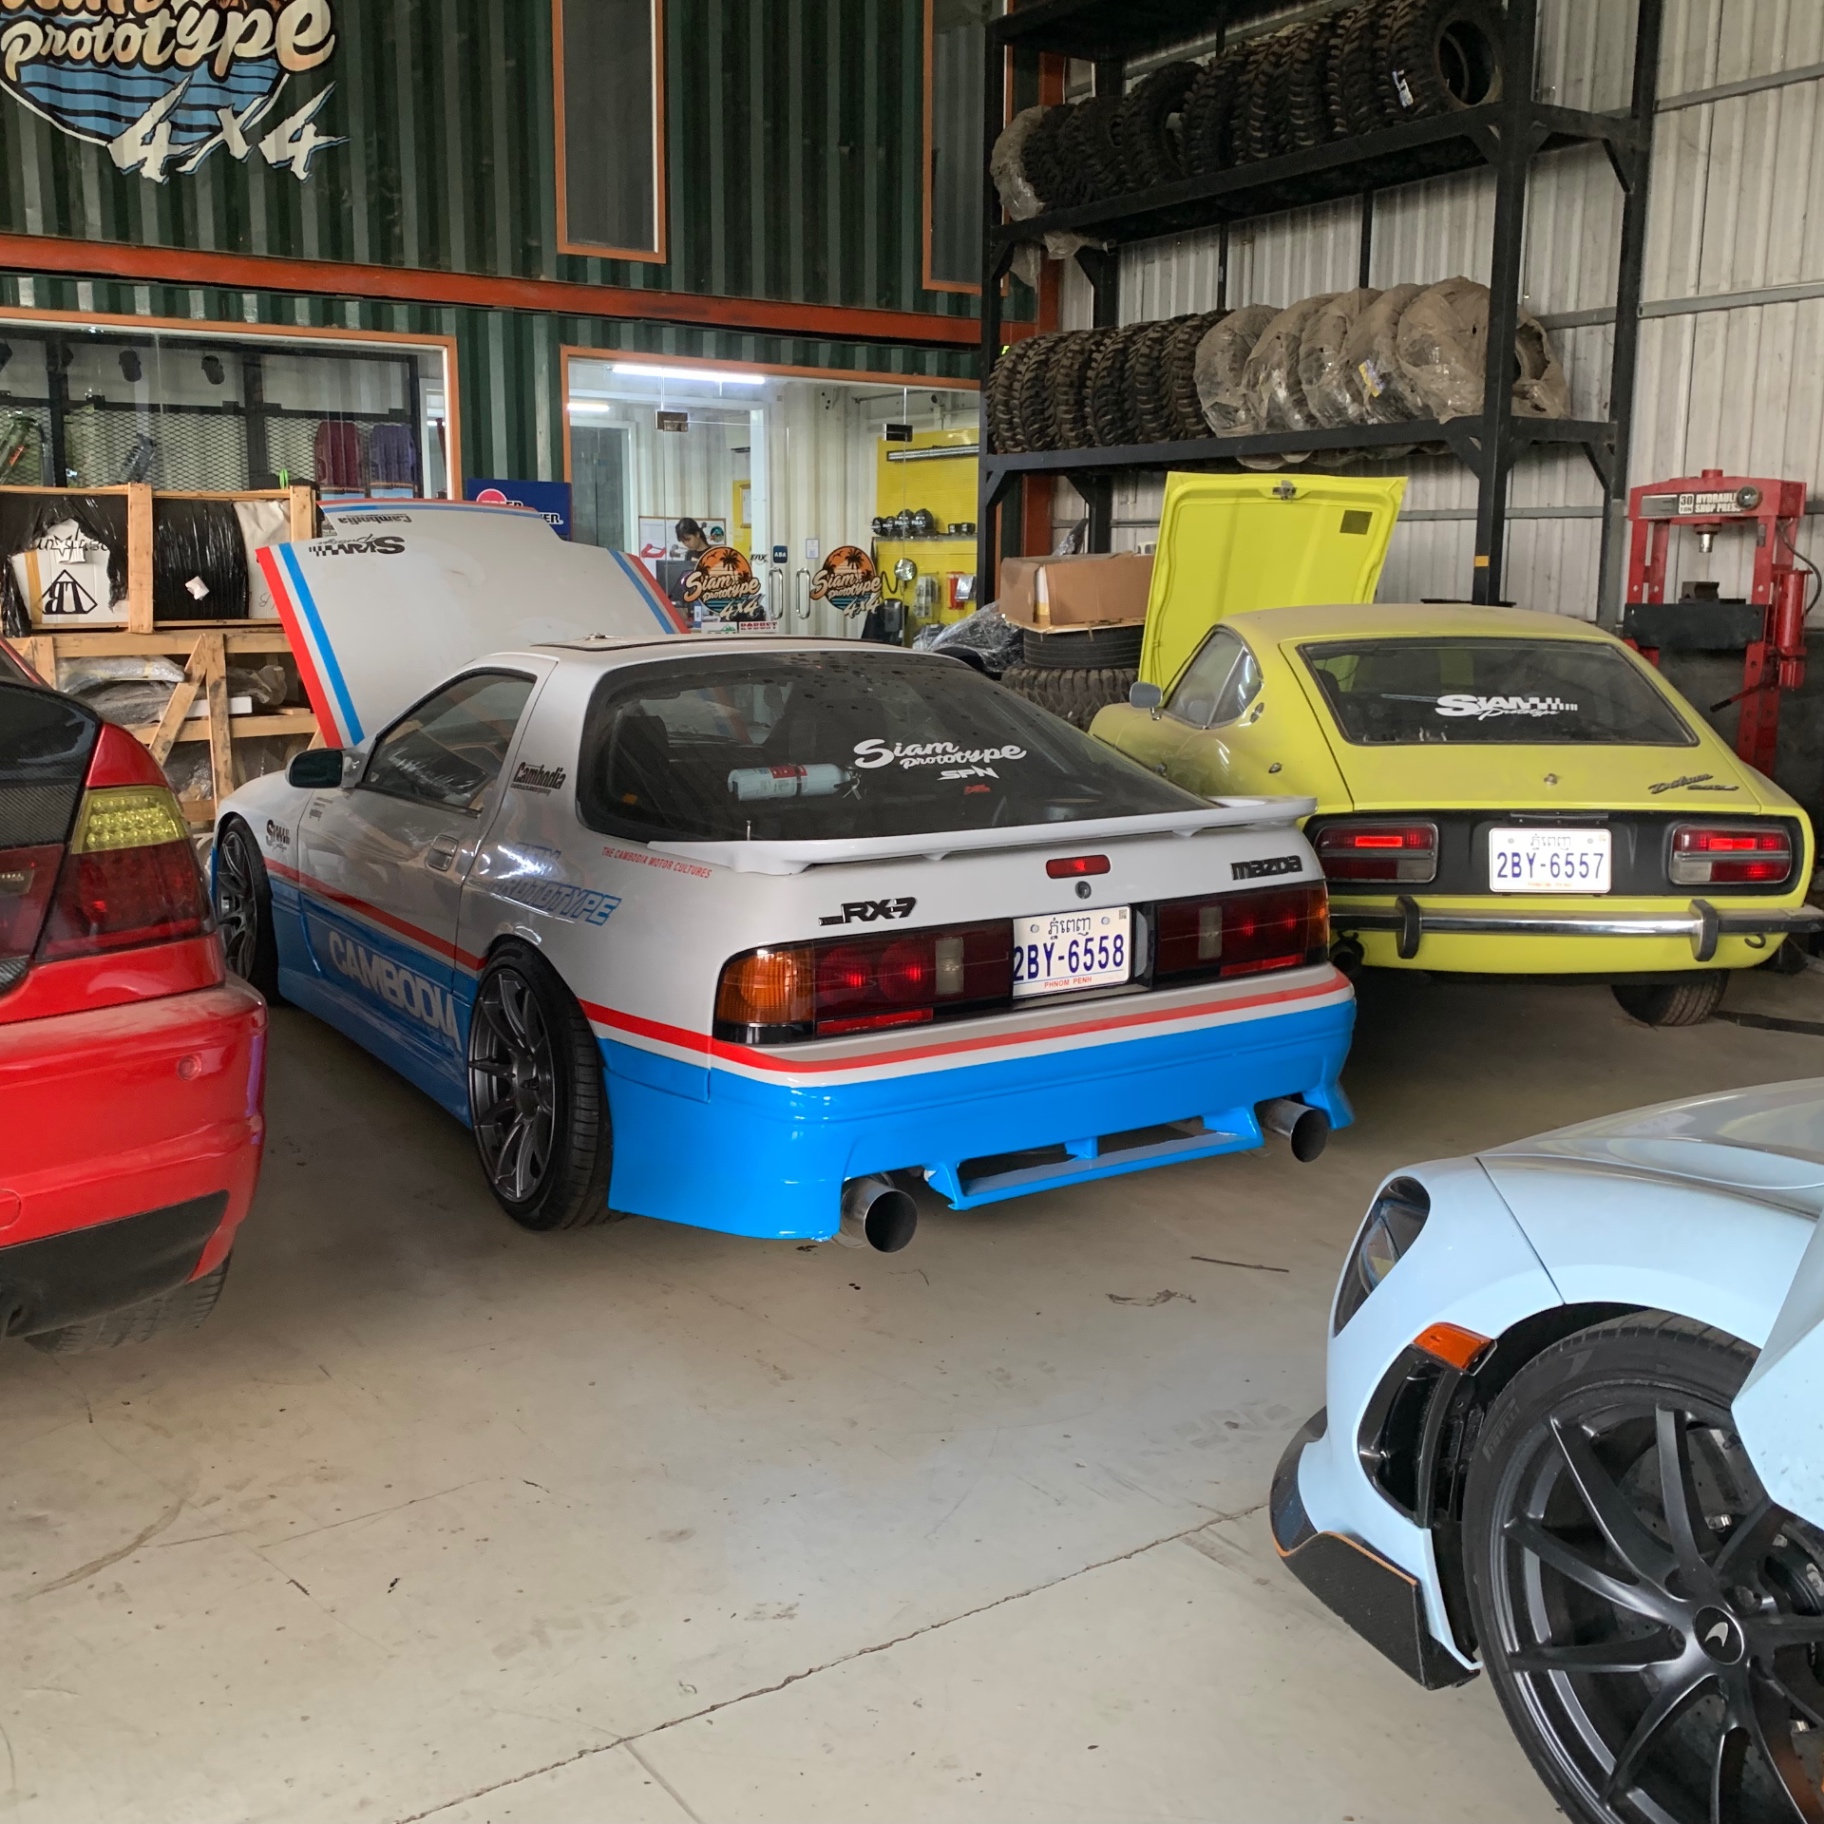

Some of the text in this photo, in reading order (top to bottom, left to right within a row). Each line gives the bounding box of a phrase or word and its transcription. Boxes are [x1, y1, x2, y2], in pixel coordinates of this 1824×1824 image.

[1, 0, 336, 82] prototype
[1680, 495, 1693, 506] 30
[1695, 504, 1715, 513] SHOP
[684, 571, 732, 602] Siam
[703, 578, 761, 602] prototype
[811, 569, 855, 600] Siam
[828, 577, 882, 600] prototype
[853, 738, 960, 769] Siam
[899, 744, 1027, 770] prototype
[513, 761, 567, 790] Cambodia
[937, 765, 1000, 781] SPN
[601, 846, 713, 879] THE CAMBODIA MOTOR CULTURES
[1496, 852, 1604, 879] 2BY-6557
[840, 896, 917, 924] RX-7
[1048, 917, 1091, 940] ភ្នំពេញ
[1013, 933, 1125, 981] 2BY-6558
[329, 930, 463, 1053] CAMBODIA
[1044, 976, 1093, 989] PHNOM PENH
